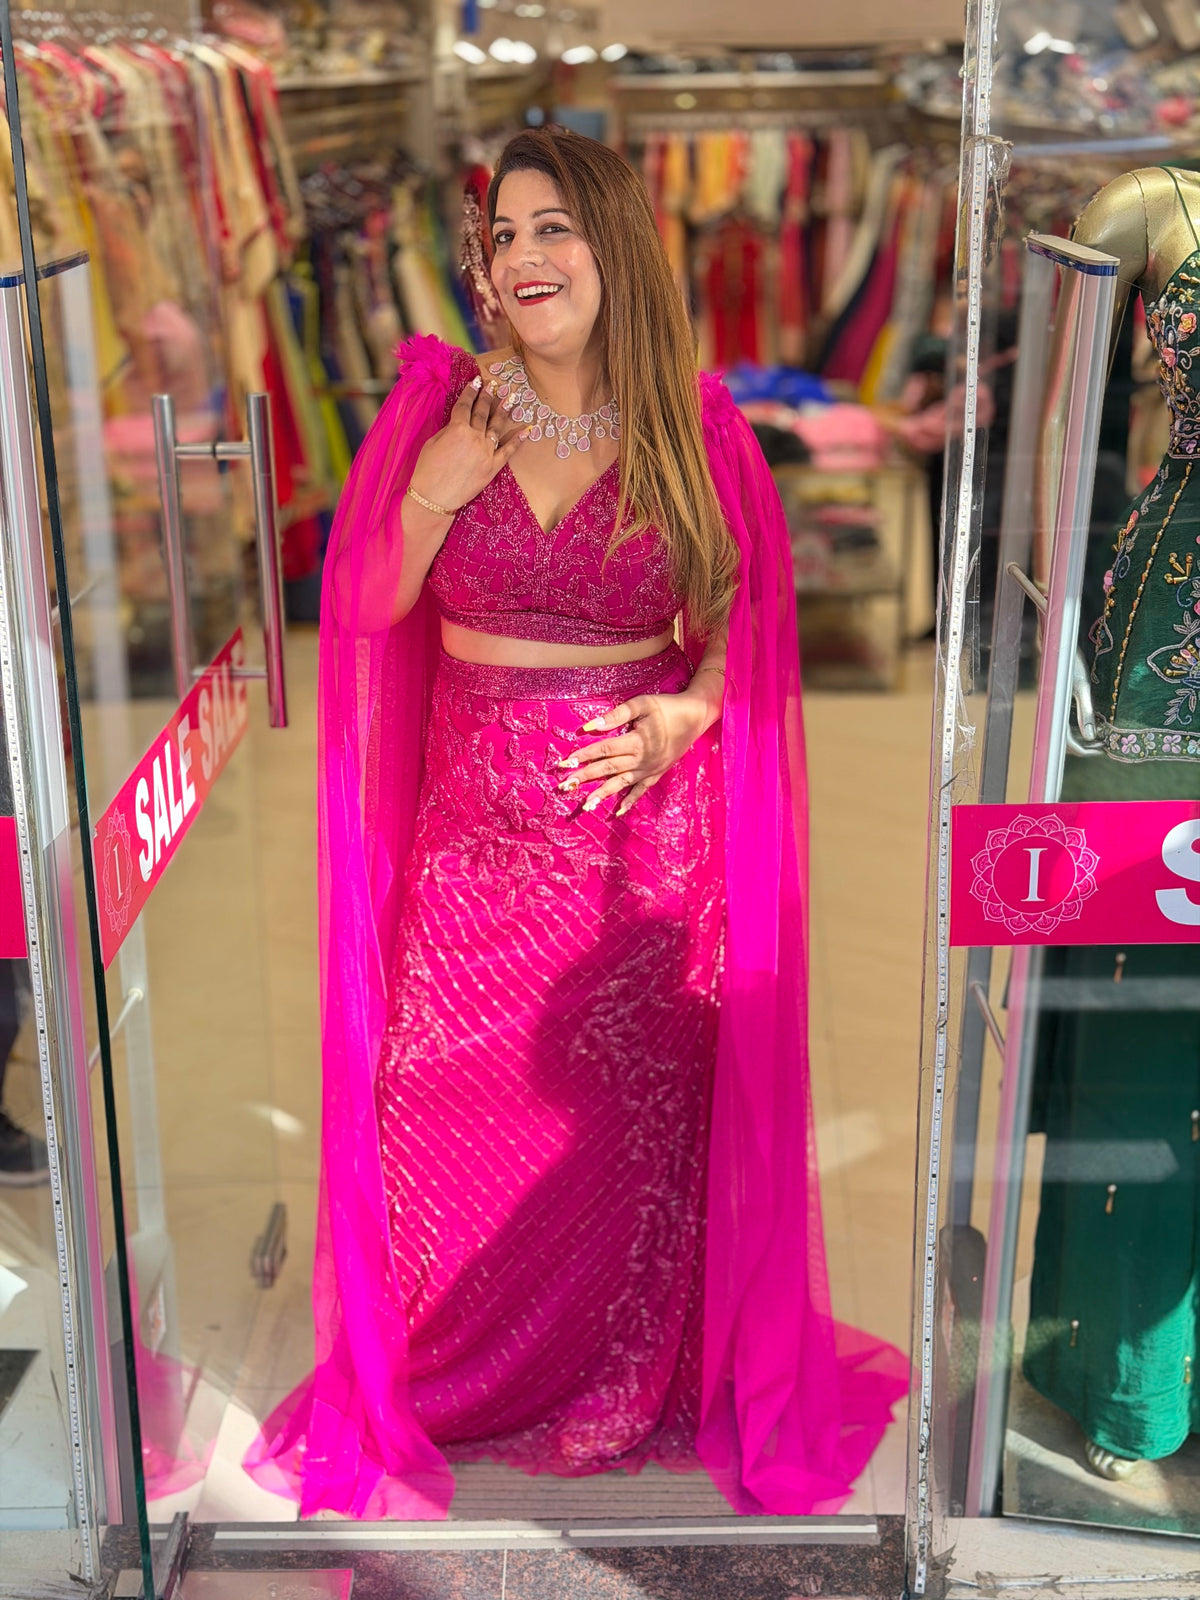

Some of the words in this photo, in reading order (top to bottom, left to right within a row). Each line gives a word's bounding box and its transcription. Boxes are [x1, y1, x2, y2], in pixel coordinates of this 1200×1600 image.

[135, 714, 196, 882] SALE
[198, 640, 247, 781] SALE
[1021, 847, 1048, 902] I
